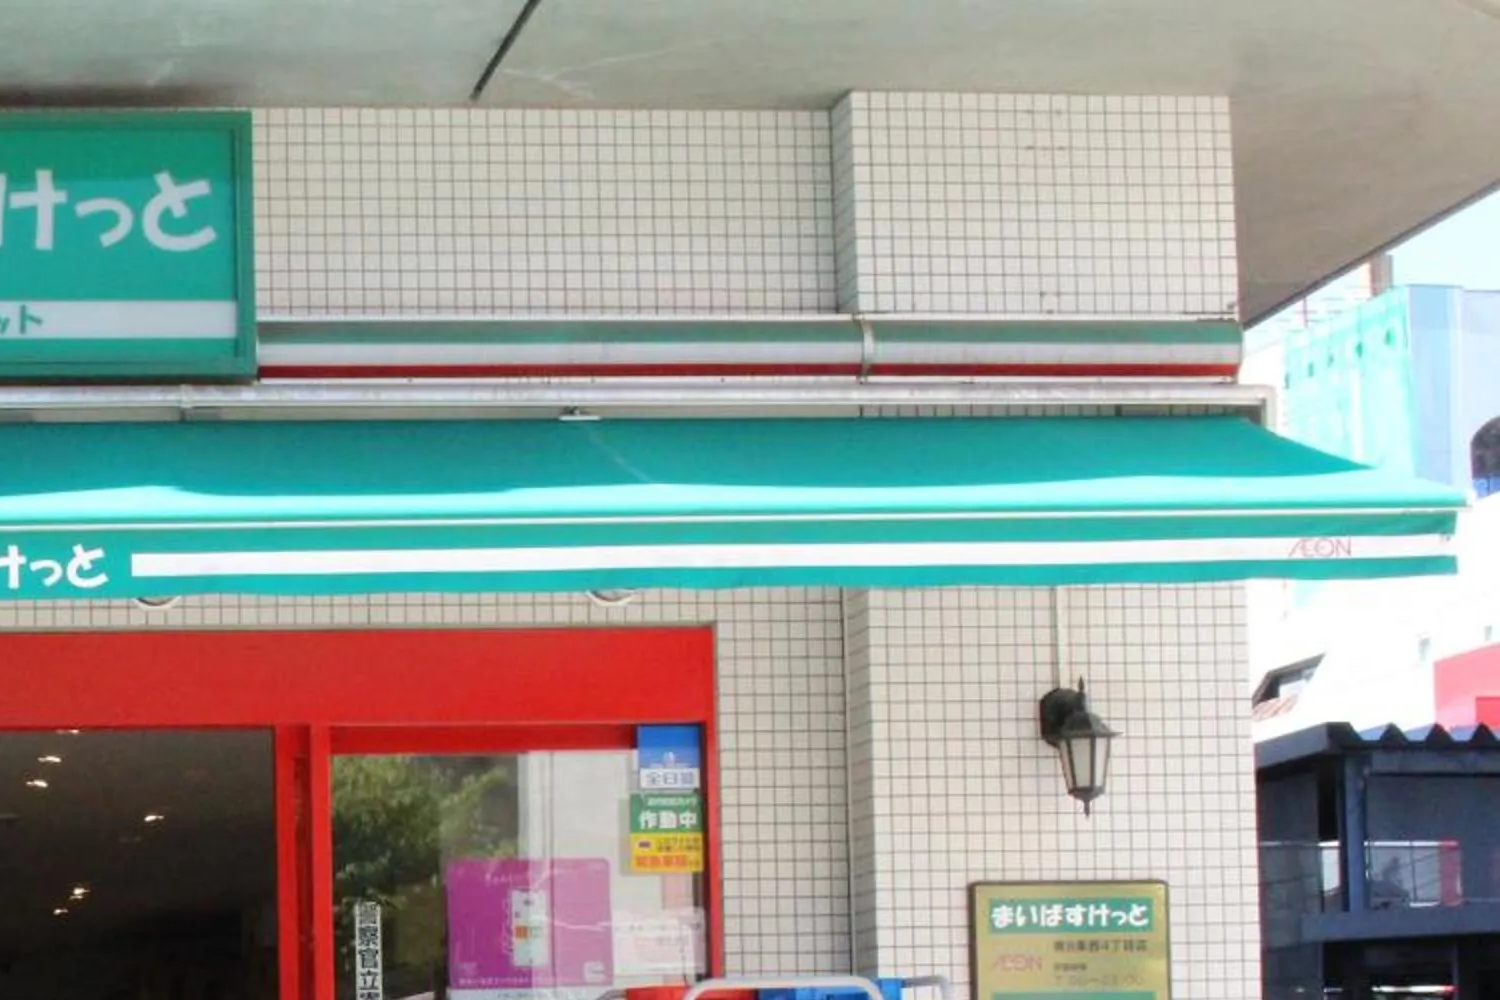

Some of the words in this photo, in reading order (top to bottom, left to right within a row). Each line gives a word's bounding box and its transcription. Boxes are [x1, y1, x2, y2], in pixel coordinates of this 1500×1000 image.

[638, 809, 697, 829] 作動中
[990, 903, 1149, 929] まいばすけっと
